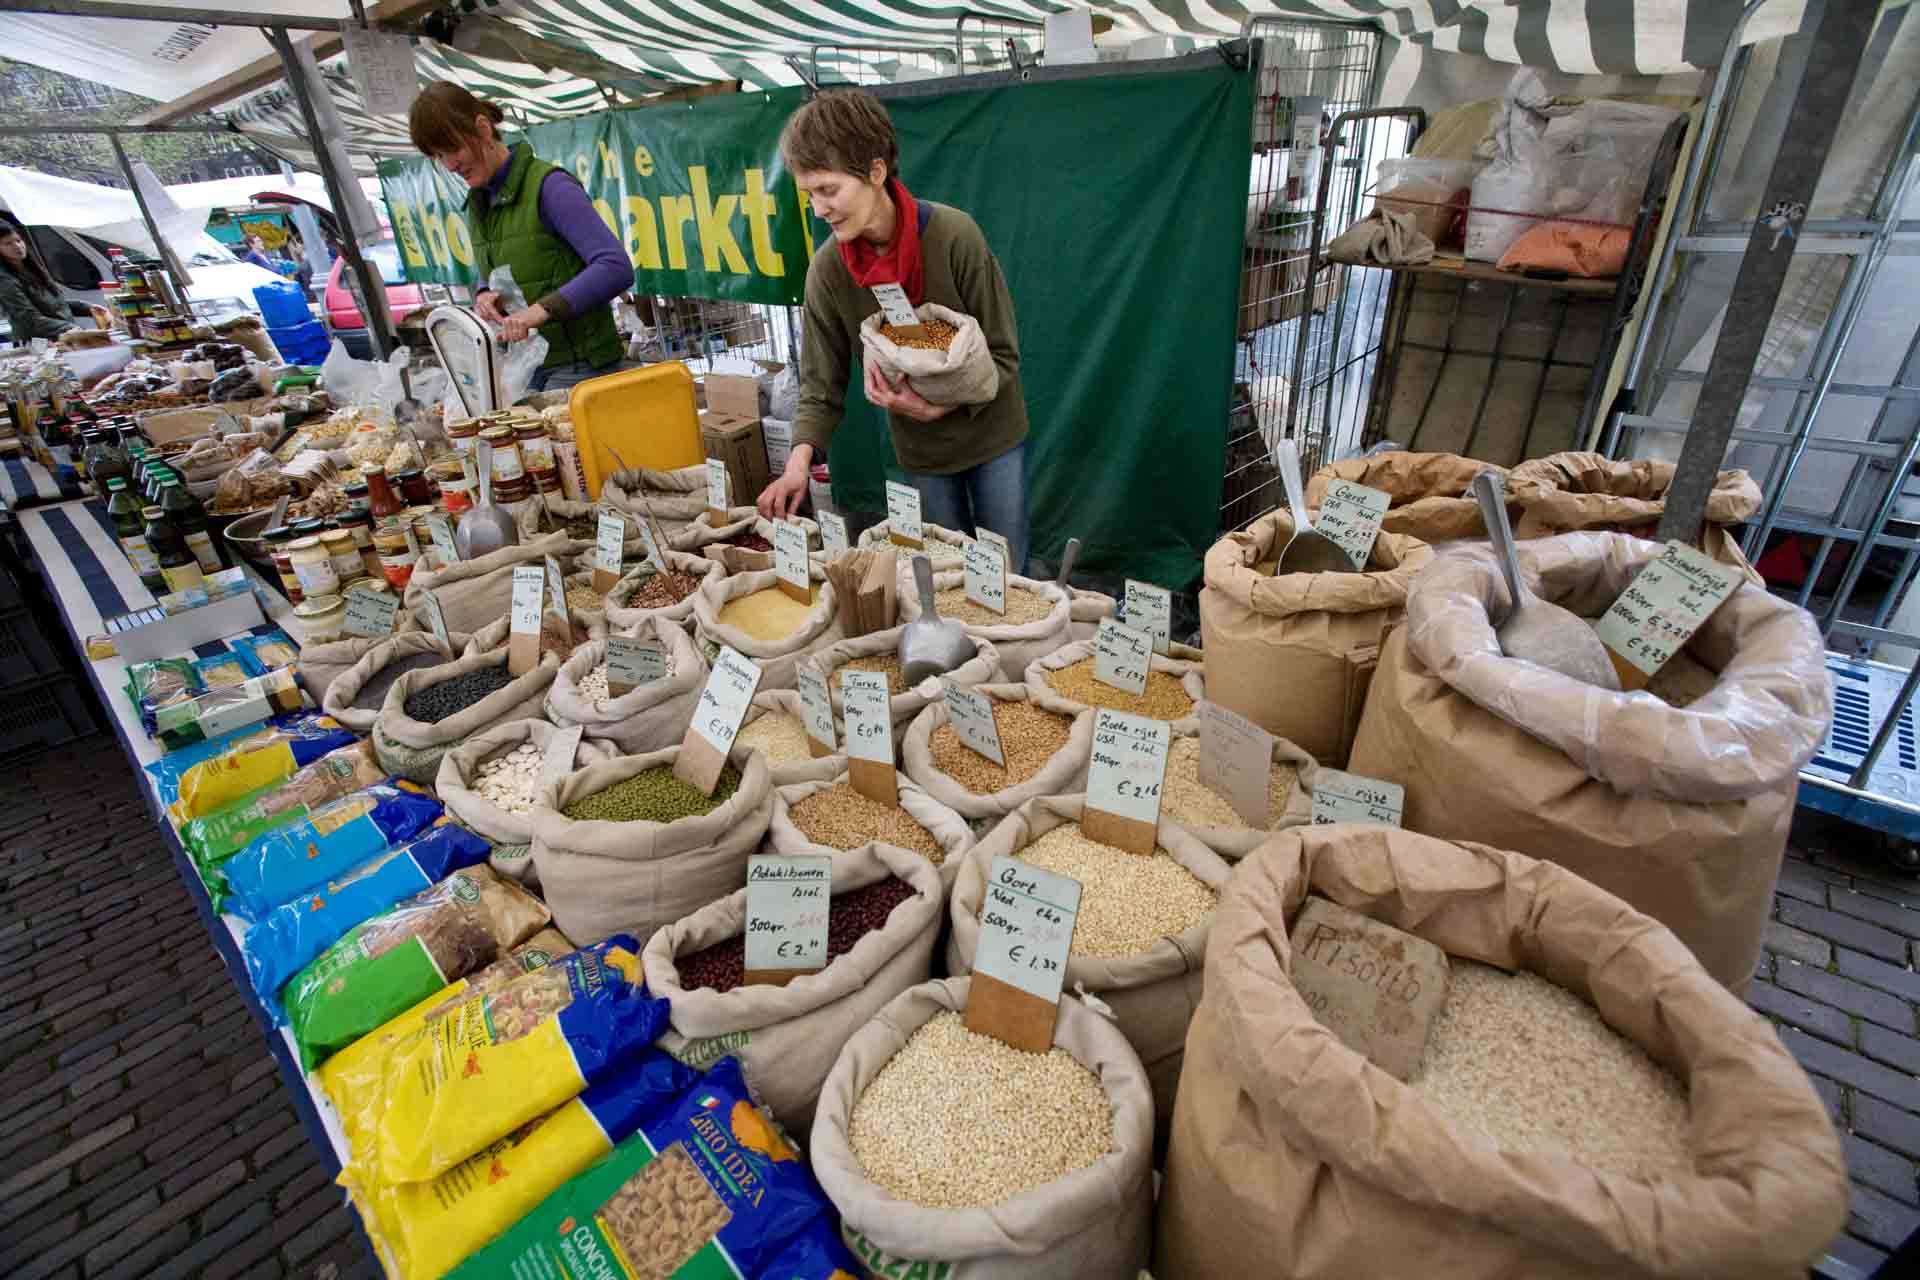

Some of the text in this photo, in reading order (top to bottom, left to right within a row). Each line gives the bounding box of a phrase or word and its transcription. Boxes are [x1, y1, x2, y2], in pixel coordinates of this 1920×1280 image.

[1000, 866, 1038, 896] Gort
[777, 939, 792, 958] €
[1008, 944, 1026, 963] €
[722, 1151, 766, 1209] IDEA
